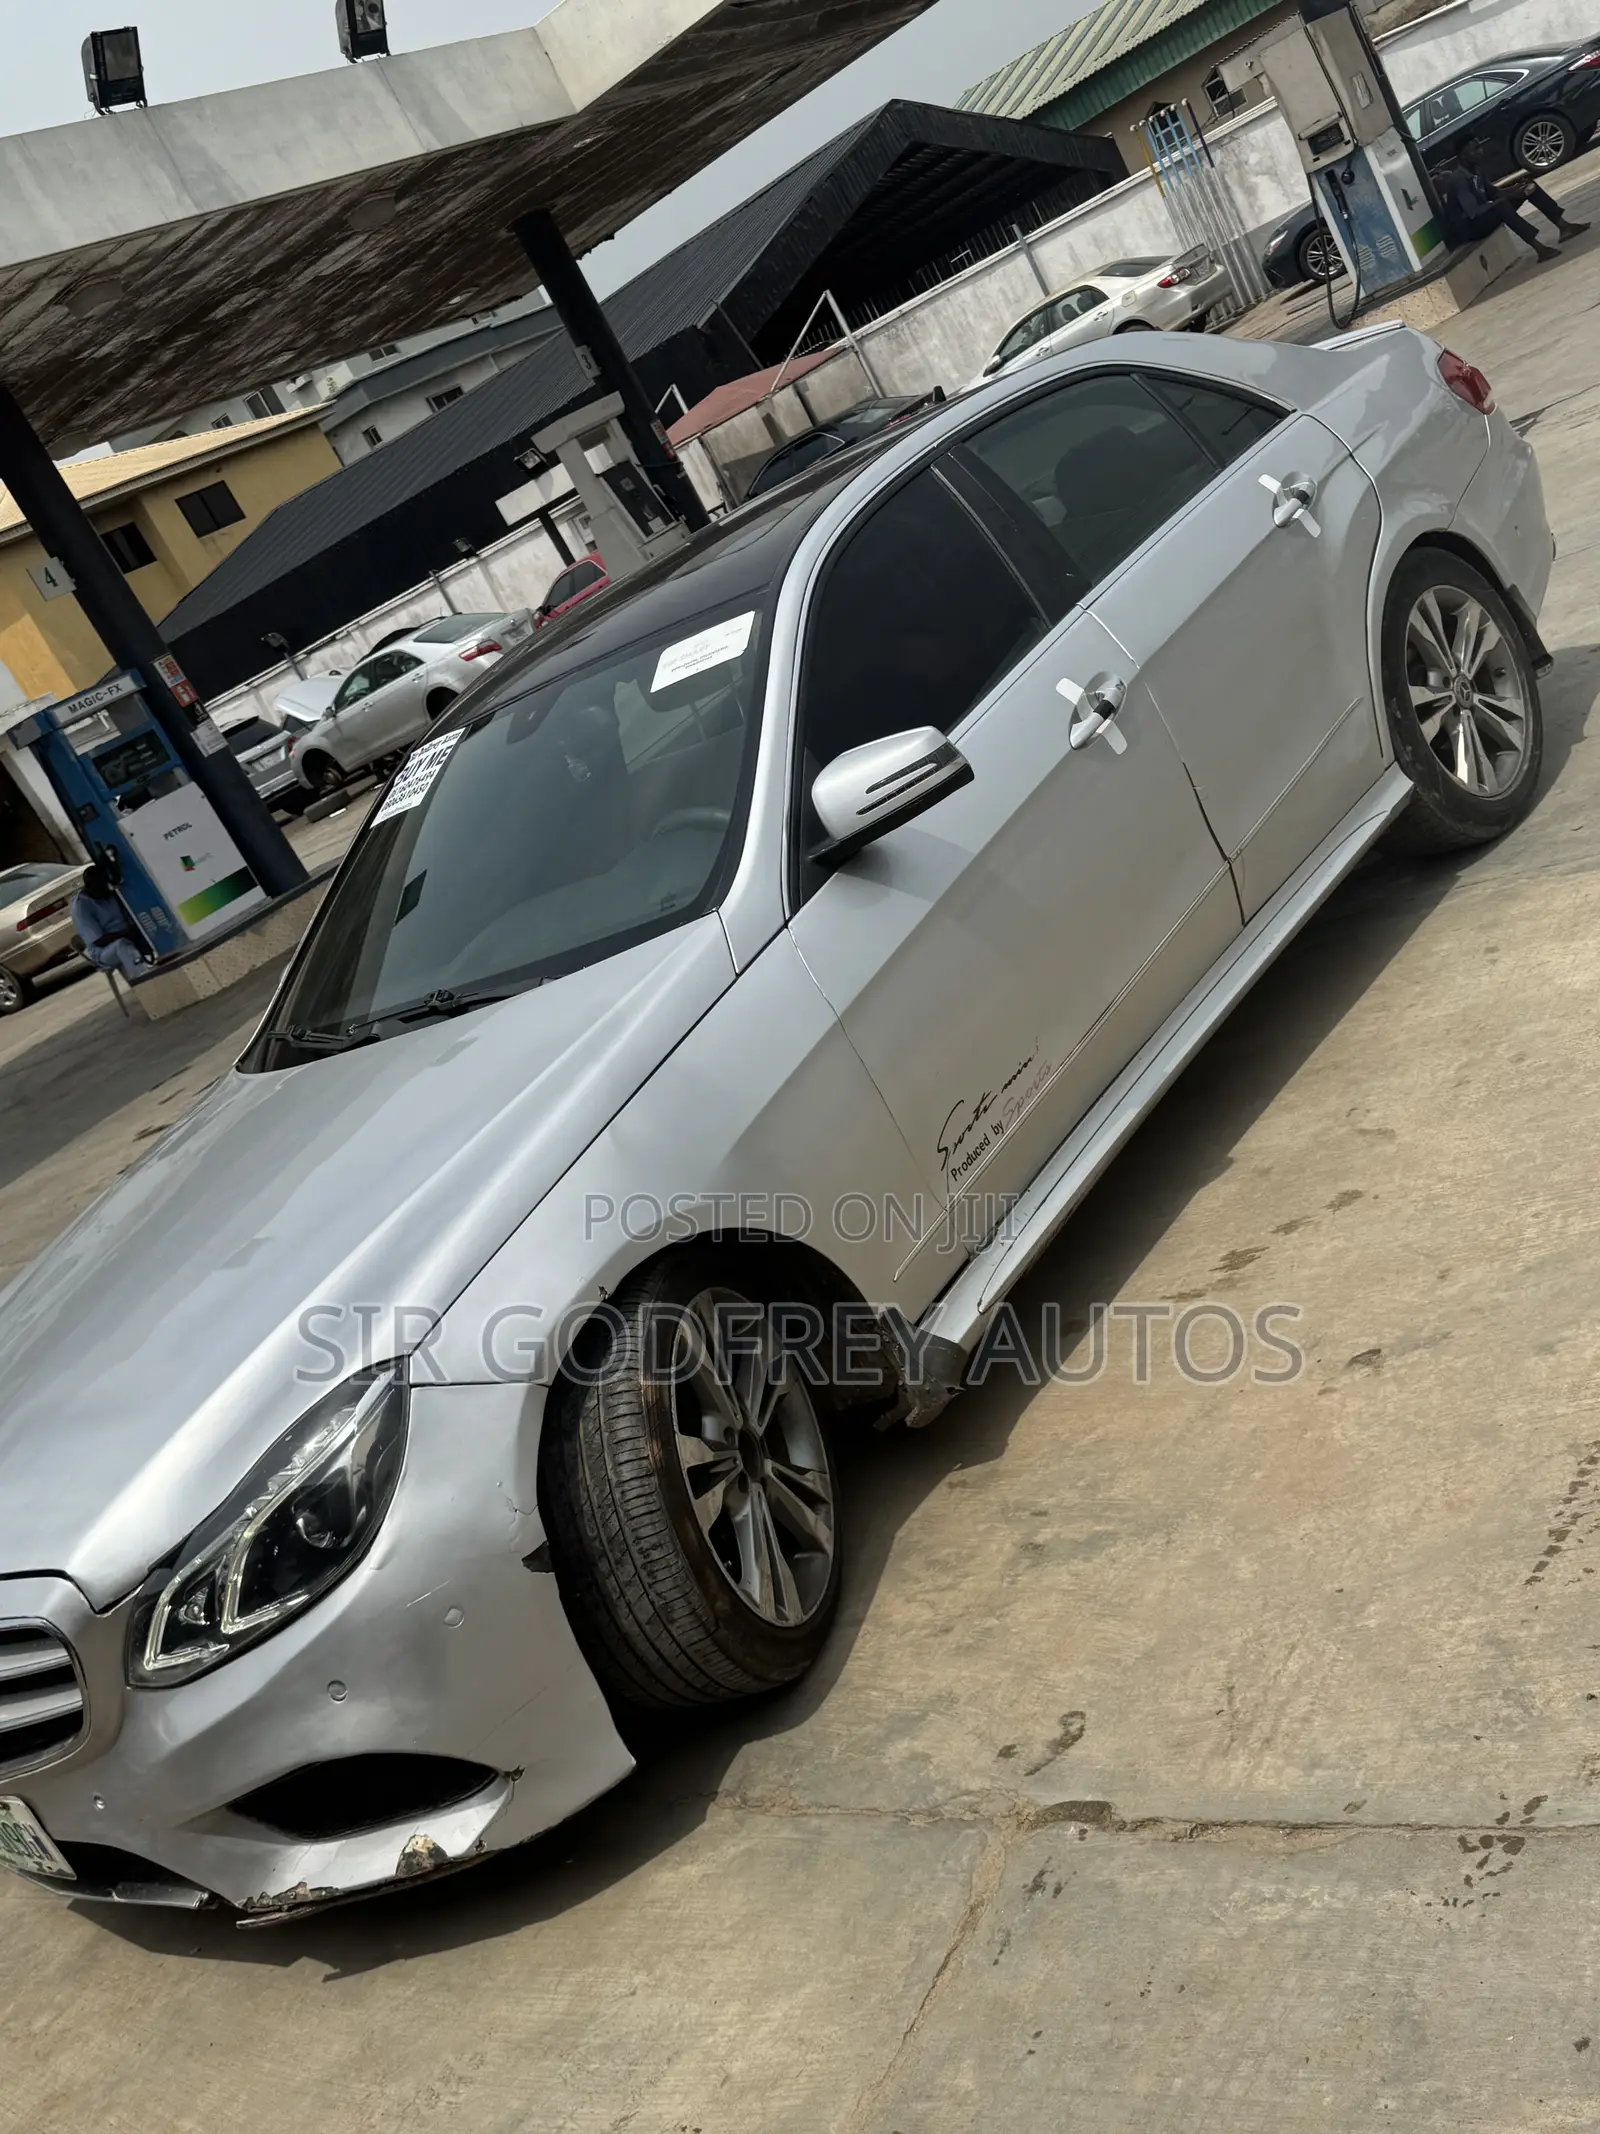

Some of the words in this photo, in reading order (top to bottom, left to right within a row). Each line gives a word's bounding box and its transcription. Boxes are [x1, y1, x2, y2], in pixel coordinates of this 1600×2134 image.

[44, 567, 59, 588] 4
[68, 683, 123, 714] MAGIC-FX
[422, 745, 455, 773] ME
[163, 822, 193, 841] PETROL
[950, 1133, 991, 1182] Produced
[990, 1119, 1005, 1135] by
